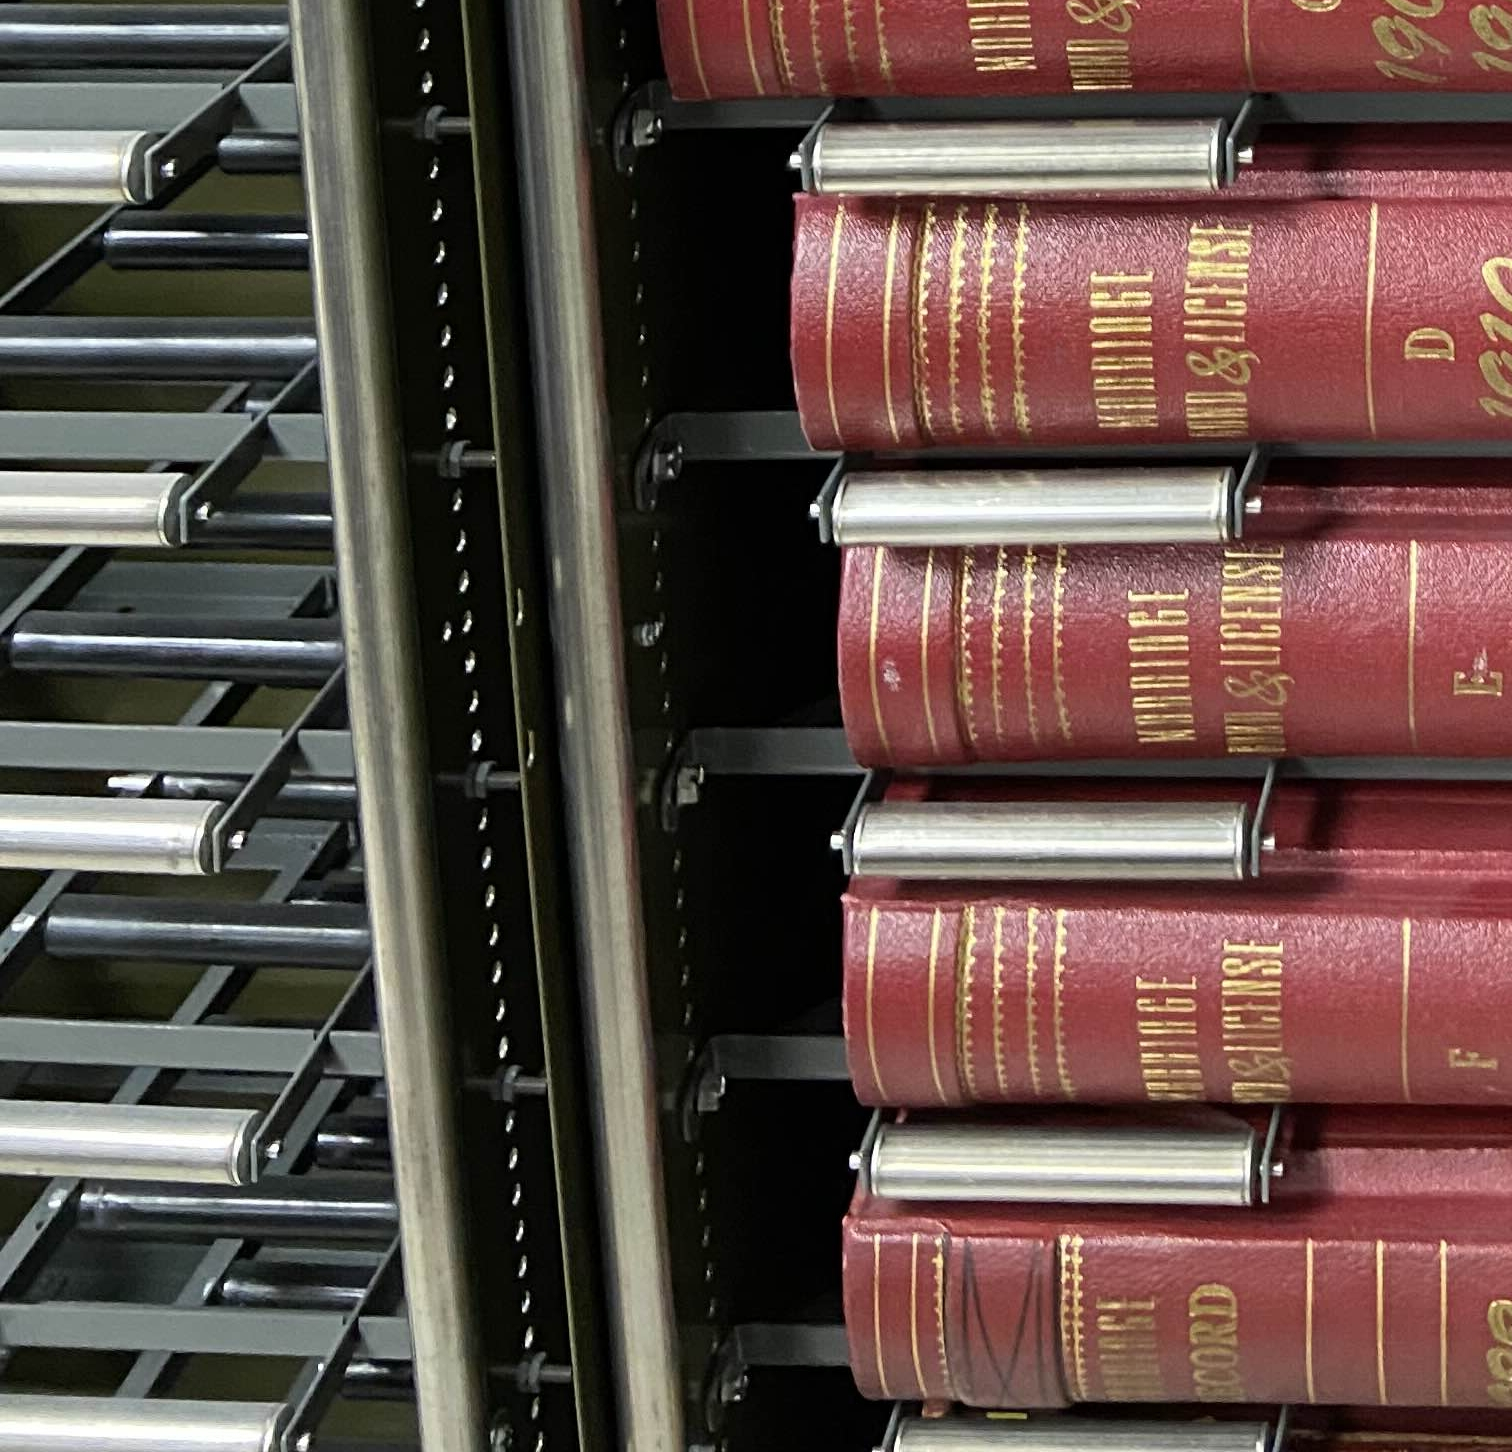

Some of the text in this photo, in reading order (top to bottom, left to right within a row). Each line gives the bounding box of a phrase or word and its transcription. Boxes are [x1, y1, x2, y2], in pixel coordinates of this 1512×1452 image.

[1182, 222, 1253, 344] LICENSE
[1089, 268, 1159, 429] MARRIAGE
[1185, 347, 1260, 386] &
[1404, 327, 1456, 361] D
[1219, 546, 1284, 667] LICENSE
[1127, 588, 1196, 743] MARRIAGE
[1224, 669, 1295, 707] &
[1221, 938, 1284, 1052] LICENSE
[1448, 1048, 1498, 1070] F
